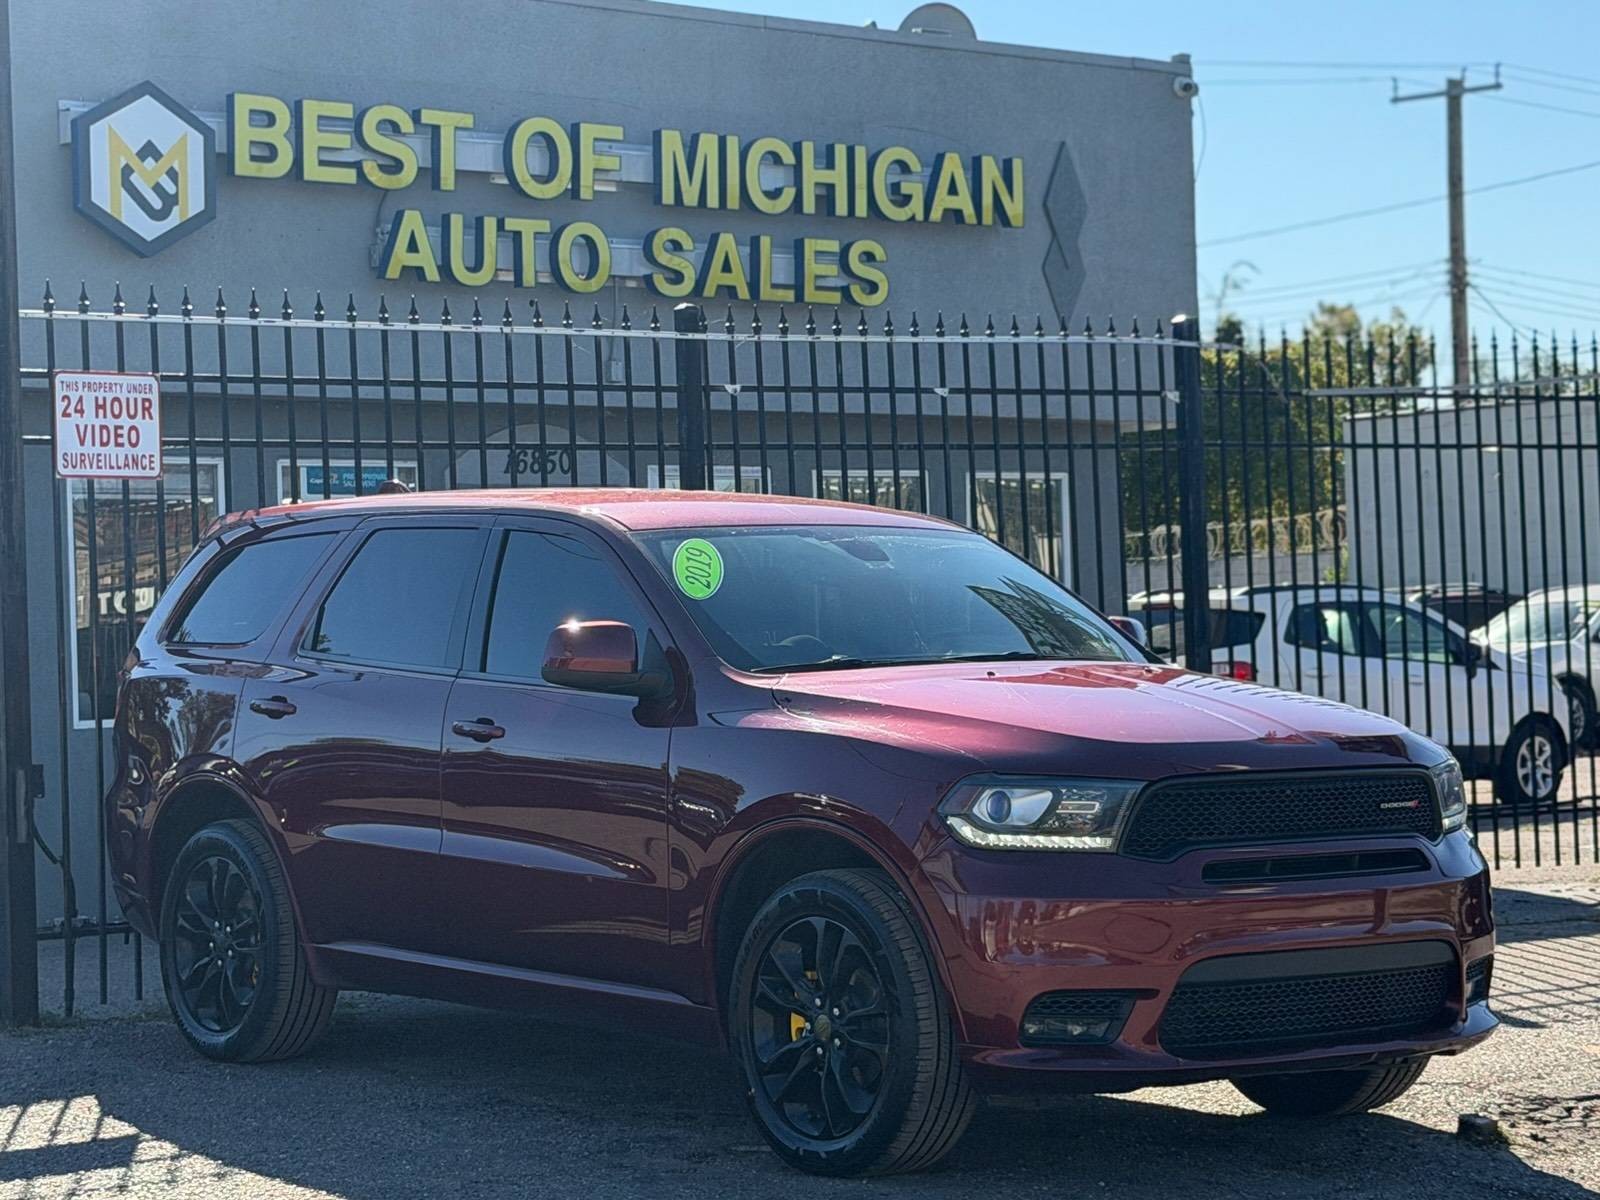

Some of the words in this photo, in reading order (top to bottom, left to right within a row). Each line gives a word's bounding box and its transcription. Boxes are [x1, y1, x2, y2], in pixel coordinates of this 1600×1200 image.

[229, 91, 475, 192] BEST
[505, 115, 625, 201] OF
[655, 128, 1025, 229] MICHIGAN
[380, 208, 612, 294] AUTO
[647, 226, 890, 308] SALES
[60, 380, 80, 393] THIS
[82, 381, 125, 394] PROPERTY
[126, 383, 154, 395] UNDER
[60, 394, 86, 419] 24
[94, 395, 154, 421] HOUR
[75, 423, 141, 449] VIDEO
[62, 451, 156, 472] SURVEILLANCE
[685, 546, 713, 590] 2019
